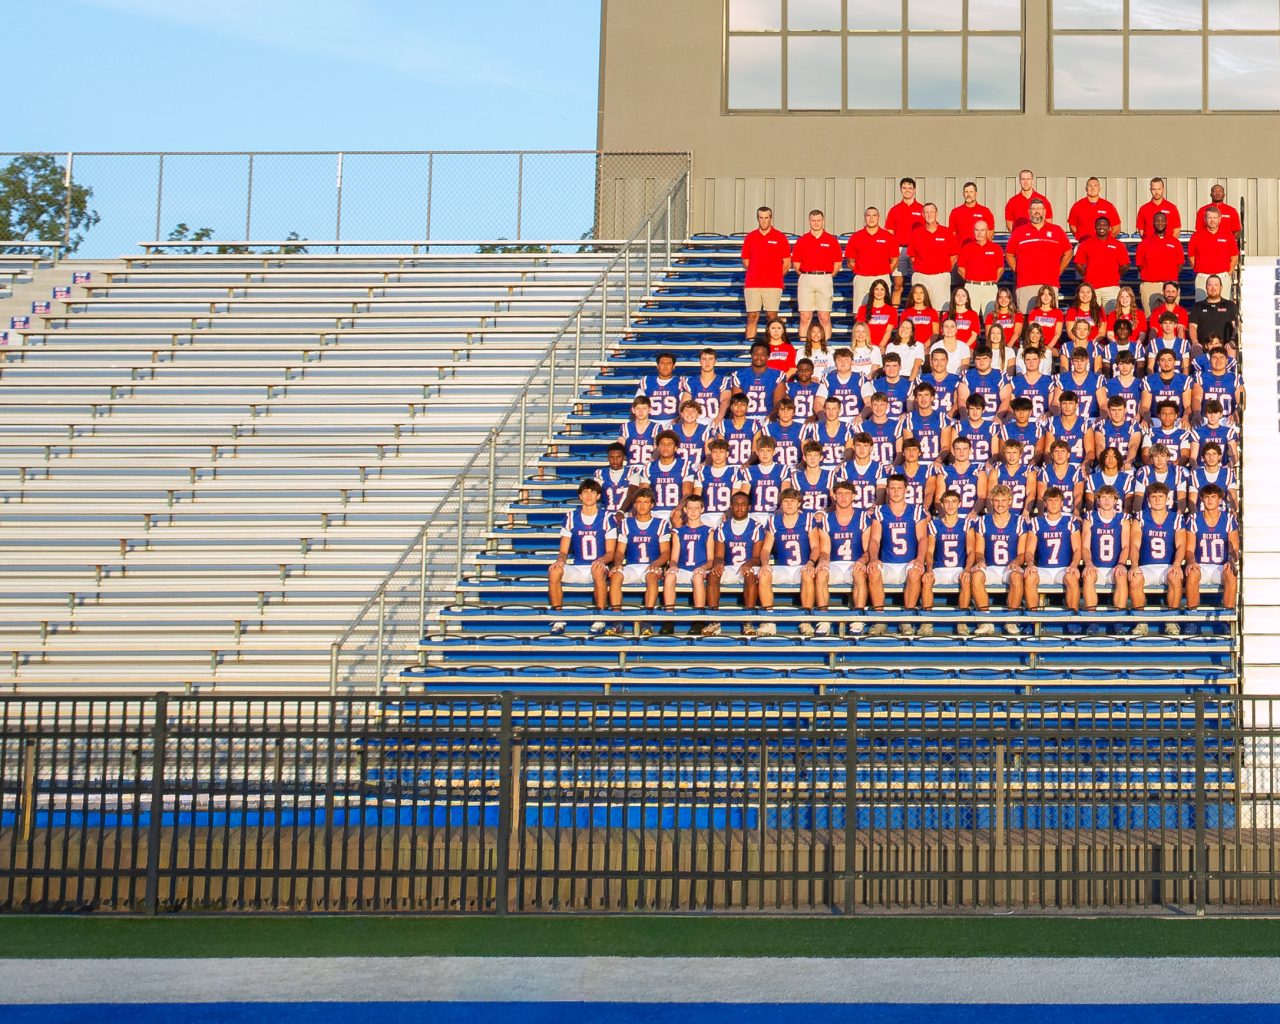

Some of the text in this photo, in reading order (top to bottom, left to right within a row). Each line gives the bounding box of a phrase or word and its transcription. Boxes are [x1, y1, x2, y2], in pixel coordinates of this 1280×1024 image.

[649, 396, 677, 415] 59
[698, 398, 719, 418] 60
[748, 392, 767, 412] 61
[794, 396, 813, 416] 61
[630, 445, 653, 465] 36
[728, 440, 751, 463] 38
[823, 446, 845, 463] 39
[920, 436, 938, 458] 41
[606, 487, 628, 510] 17
[655, 484, 679, 506] 18
[707, 487, 730, 511] 19
[755, 486, 778, 511] 19
[803, 494, 827, 510] 20
[852, 486, 875, 508] 20
[904, 486, 923, 504] 21
[582, 535, 597, 560] 0
[837, 539, 852, 560] 4
[891, 528, 907, 555] 5
[1047, 539, 1061, 564] 7
[1100, 535, 1114, 561] 8
[1151, 538, 1165, 559] 9
[1200, 539, 1224, 563] 10
[638, 543, 649, 563] 1
[686, 541, 695, 566] 1
[731, 547, 746, 566] 2
[786, 541, 801, 566] 3
[944, 541, 958, 567] 5
[994, 541, 1008, 565] 6
